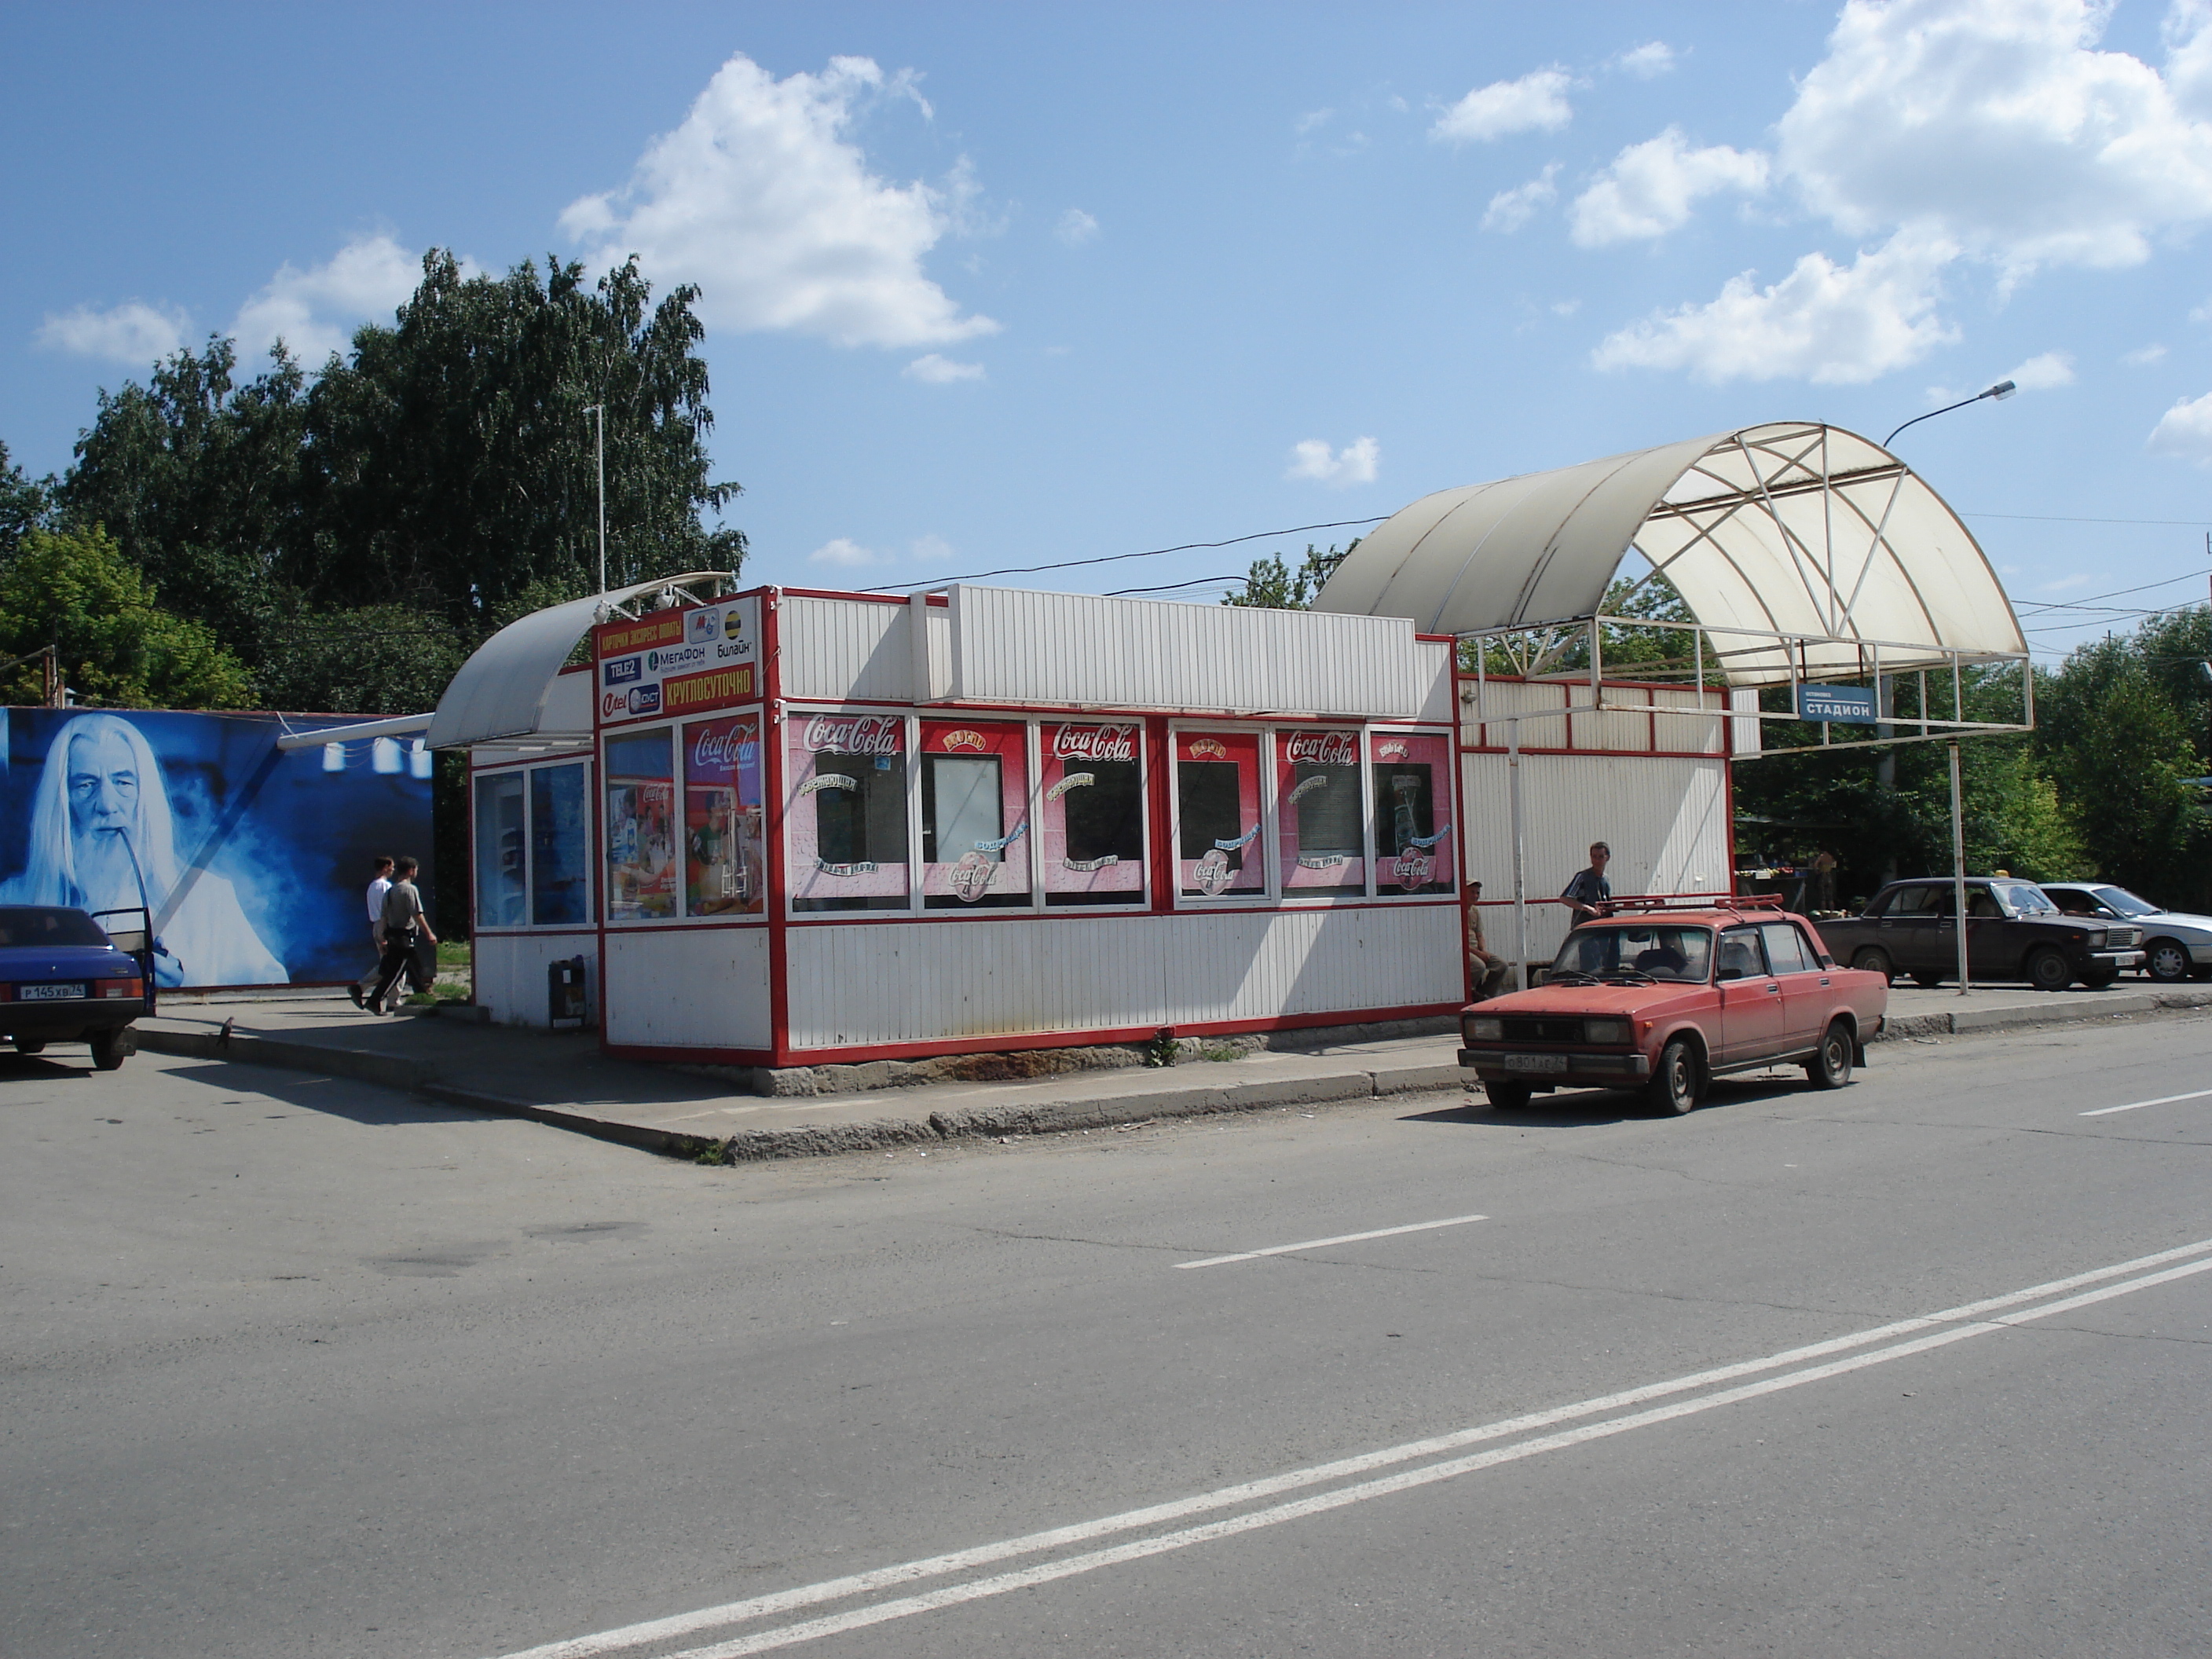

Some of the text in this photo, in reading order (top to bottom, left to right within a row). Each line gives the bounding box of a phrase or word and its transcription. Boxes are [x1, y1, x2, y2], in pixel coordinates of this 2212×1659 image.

[602, 620, 682, 651] КАРТОЧКИ ЭКСПРЕСС ОПЛАТЫ
[610, 661, 635, 678] TELE2
[667, 669, 750, 706] КРУГЛОСУТОЧНО
[1807, 703, 1870, 716] СТАДИОН
[695, 723, 757, 766] Coca-Cola
[804, 713, 899, 756] Coca-Cola
[1053, 722, 1136, 761] Coca-Cola
[1286, 731, 1356, 766] Coca-Cola
